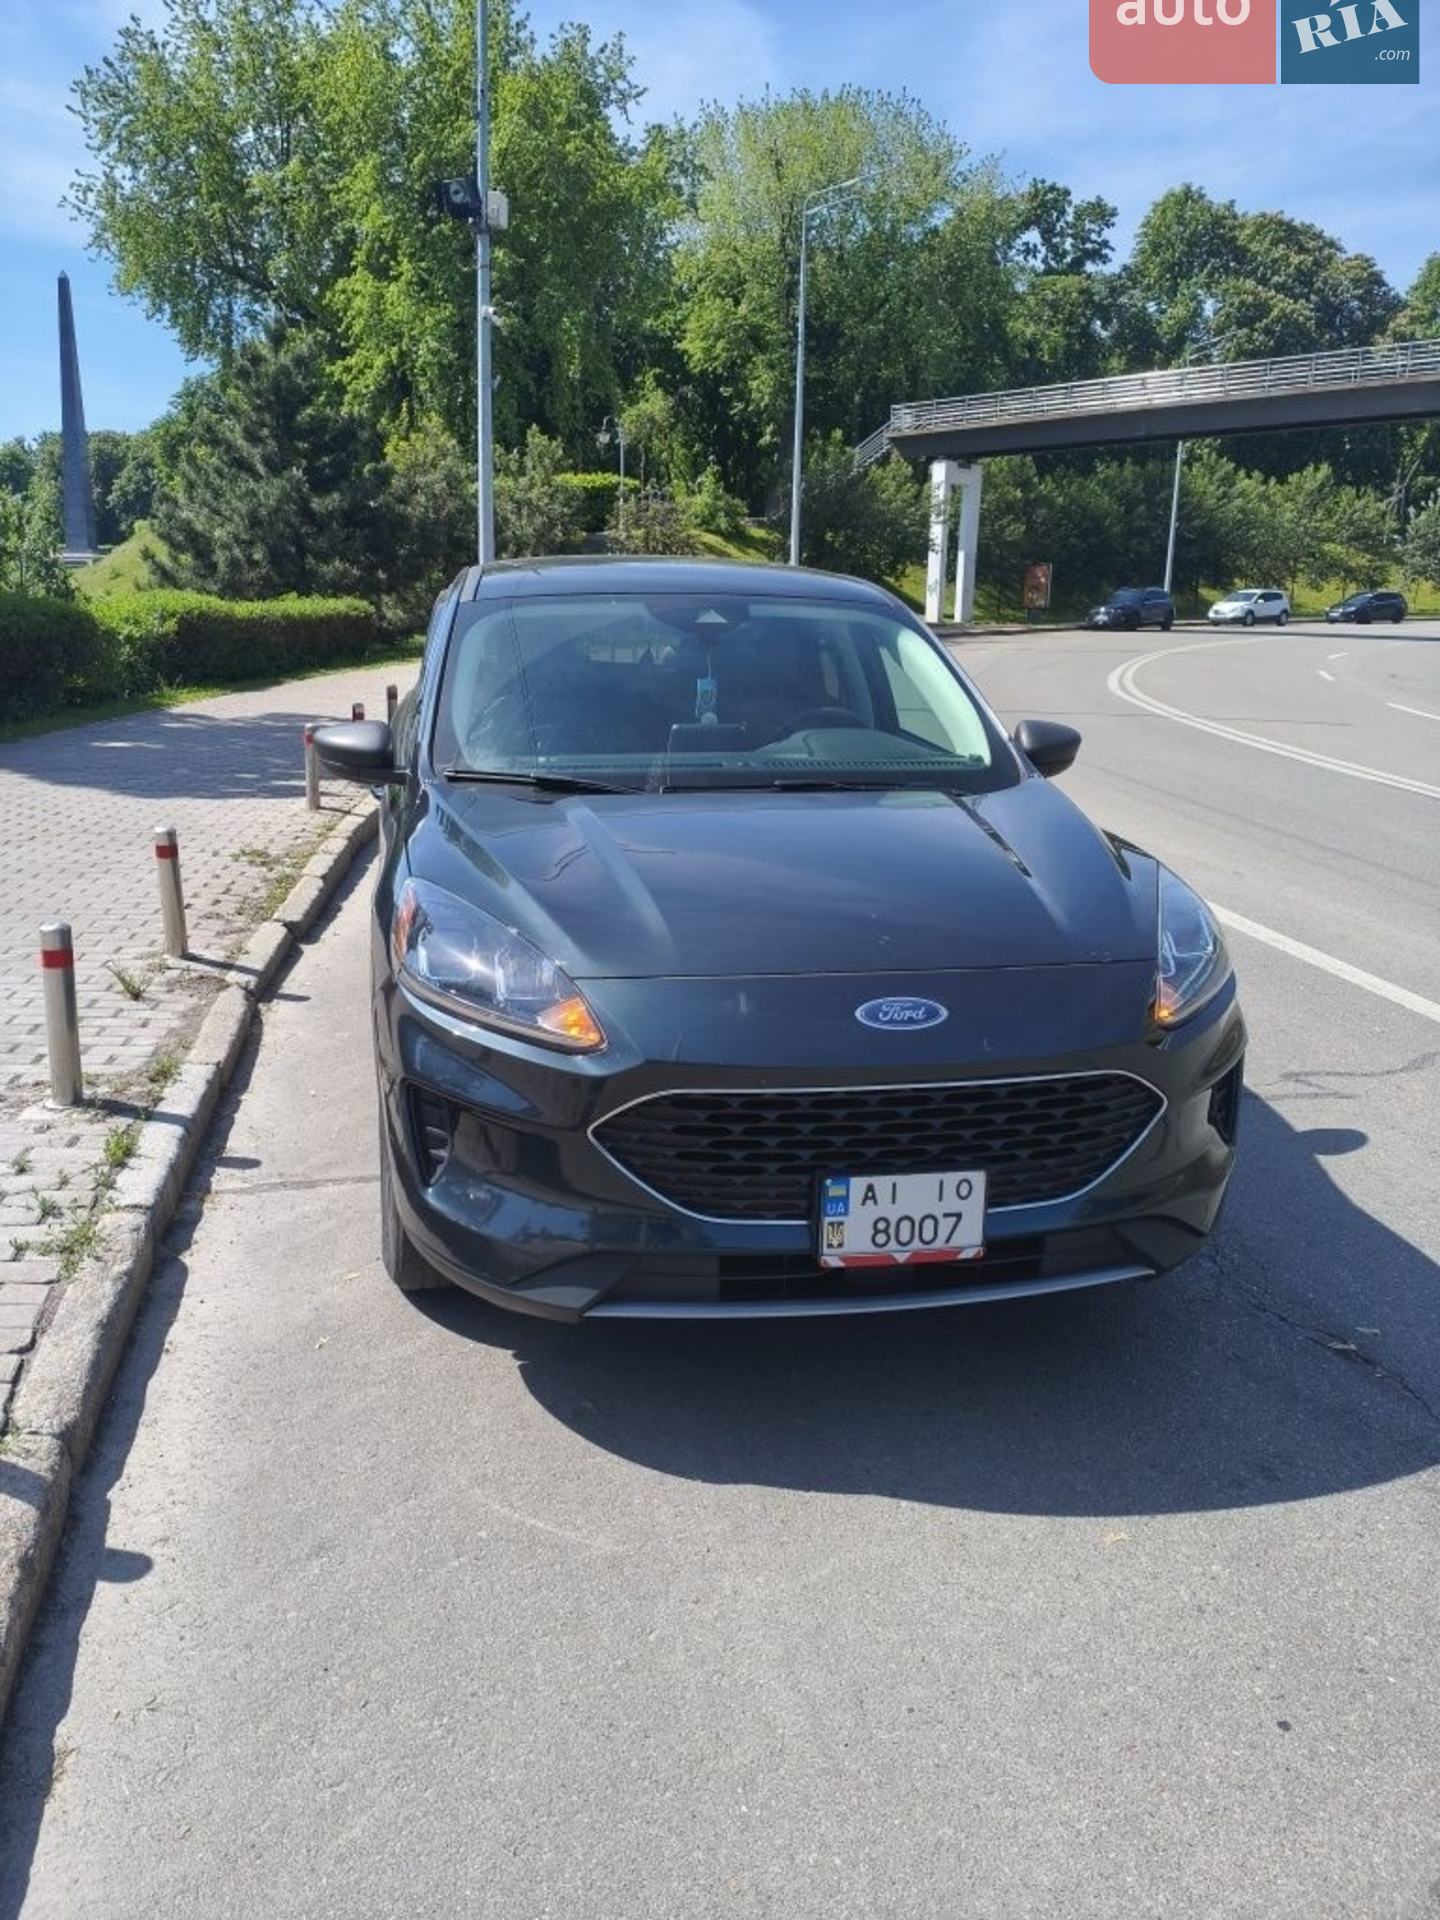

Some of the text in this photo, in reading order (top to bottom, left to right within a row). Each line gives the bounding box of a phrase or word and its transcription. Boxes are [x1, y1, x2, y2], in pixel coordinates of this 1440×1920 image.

[879, 1002, 926, 1021] Ford
[826, 1202, 846, 1215] UA
[871, 1212, 963, 1248] 8007
